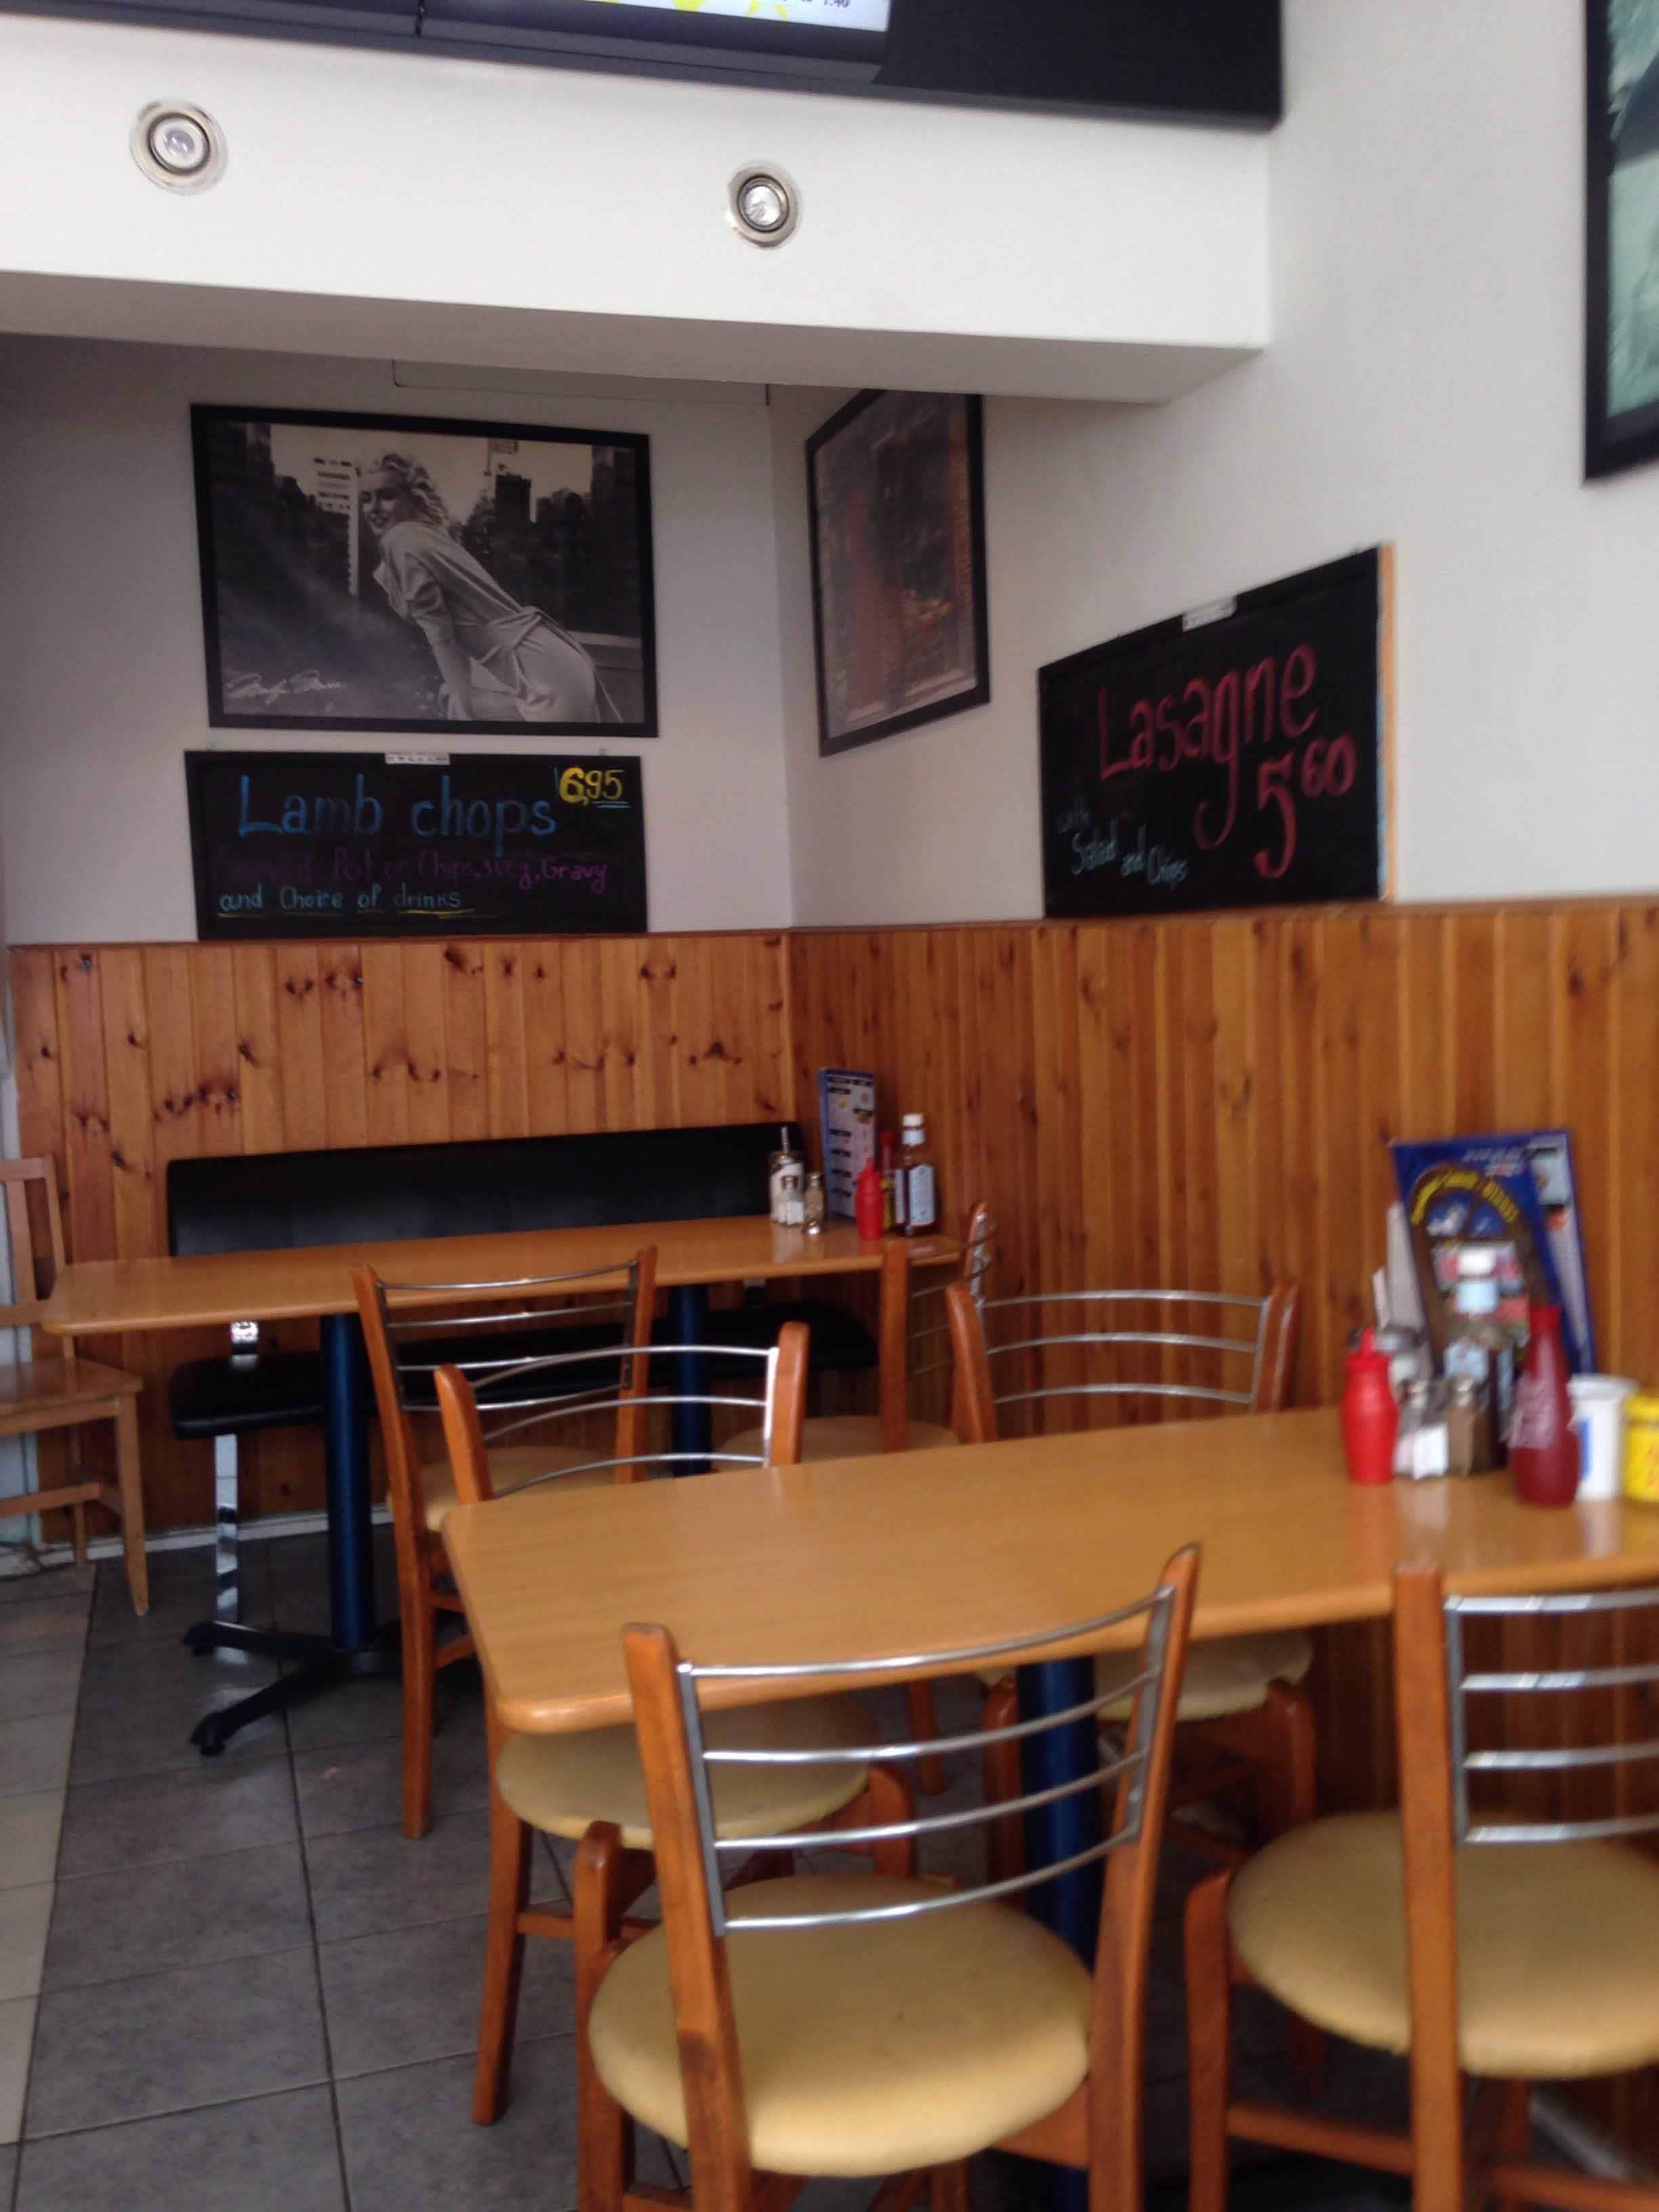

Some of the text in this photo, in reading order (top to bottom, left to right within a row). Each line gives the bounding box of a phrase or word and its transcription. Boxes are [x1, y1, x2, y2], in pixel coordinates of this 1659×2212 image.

[1097, 642, 1319, 851] Lasagne
[239, 773, 557, 858] Lamb chops
[219, 883, 264, 911] and
[356, 883, 383, 910] of
[393, 881, 462, 909] drinks
